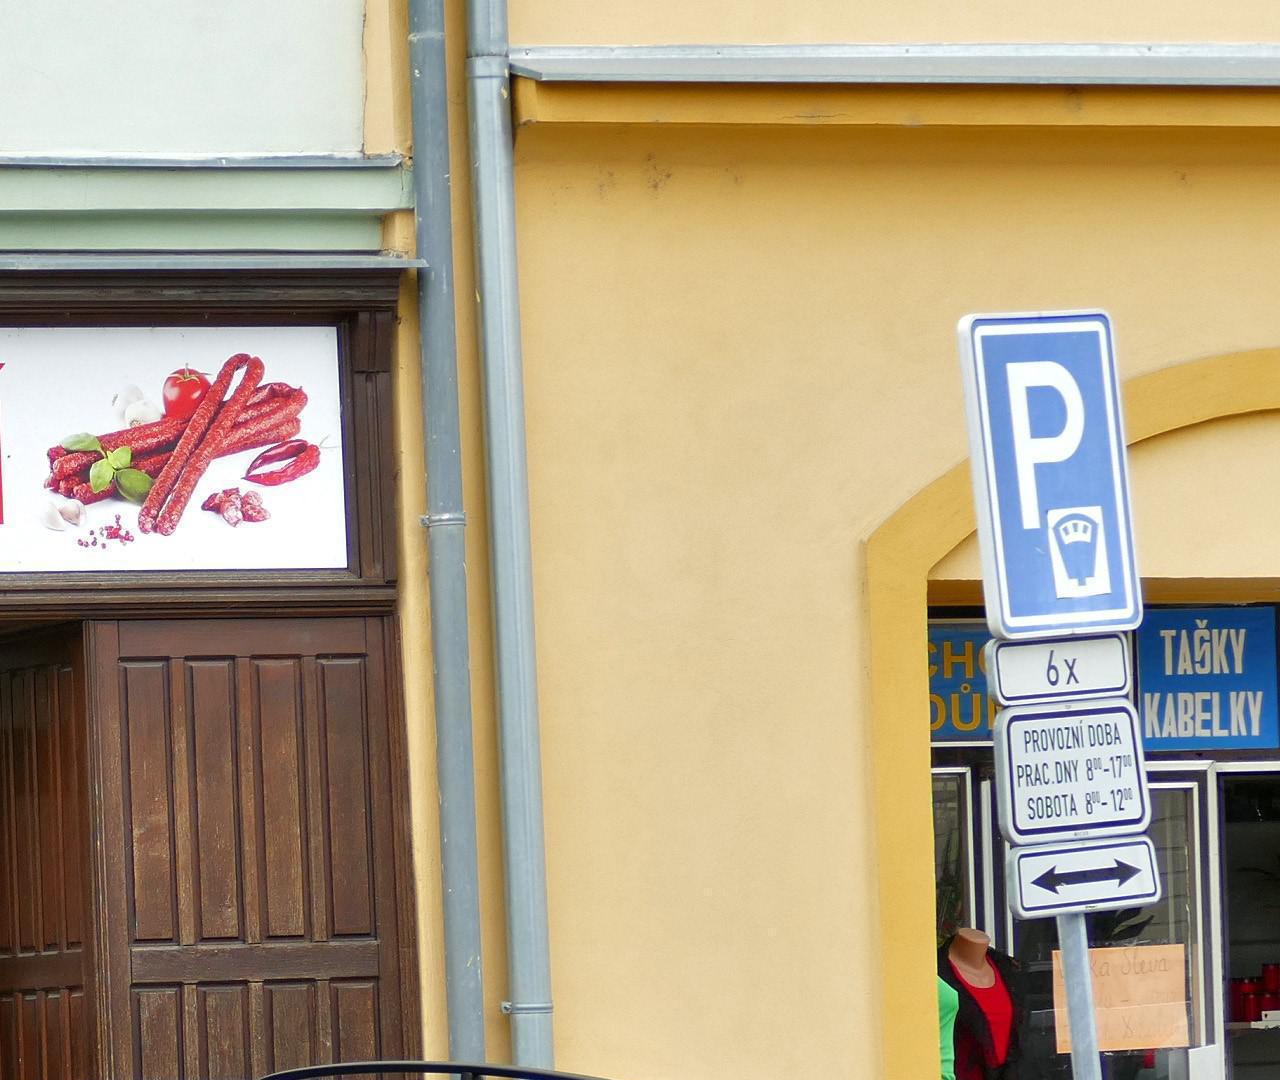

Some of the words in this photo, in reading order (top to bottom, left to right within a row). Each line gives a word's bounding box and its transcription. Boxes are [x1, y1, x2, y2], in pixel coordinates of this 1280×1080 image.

[1005, 360, 1085, 530] P
[1160, 619, 1246, 677] TAŠKY
[1023, 720, 1085, 753] PROVOZNÍ
[1087, 722, 1122, 748] DOBA
[1144, 691, 1264, 739] KABELKY
[1027, 793, 1078, 820] SOBOTA
